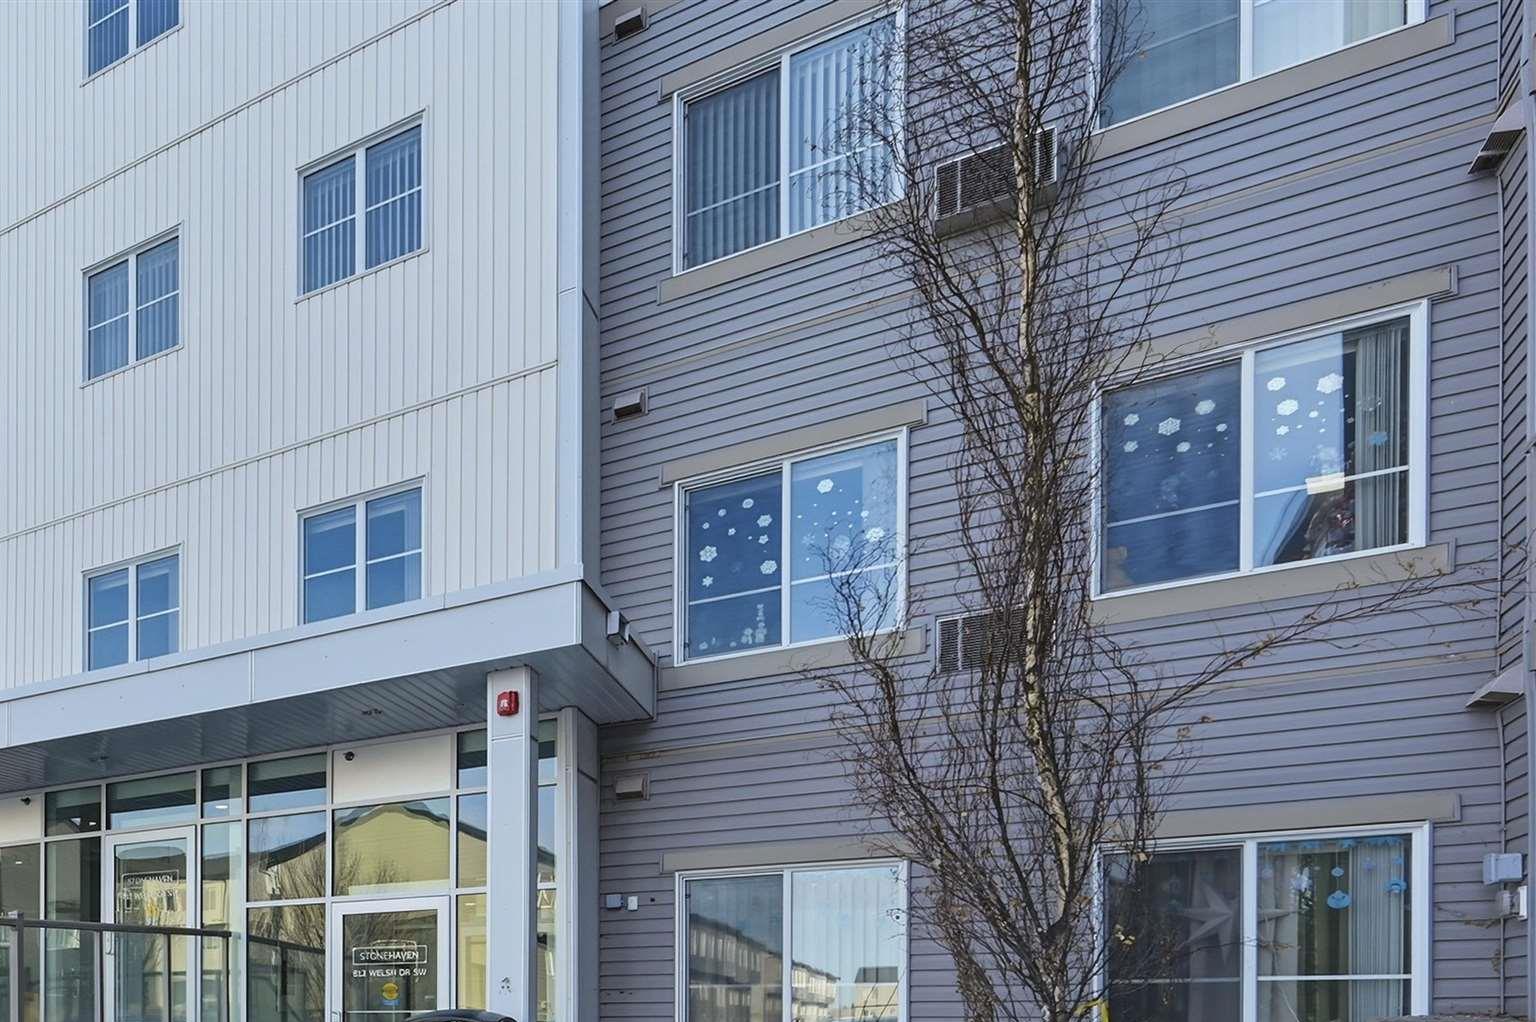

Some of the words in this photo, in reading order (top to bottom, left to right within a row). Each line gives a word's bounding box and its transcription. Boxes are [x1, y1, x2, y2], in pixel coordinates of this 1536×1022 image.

[368, 968, 397, 977] WELSH
[398, 968, 411, 977] DR
[412, 967, 428, 976] SW
